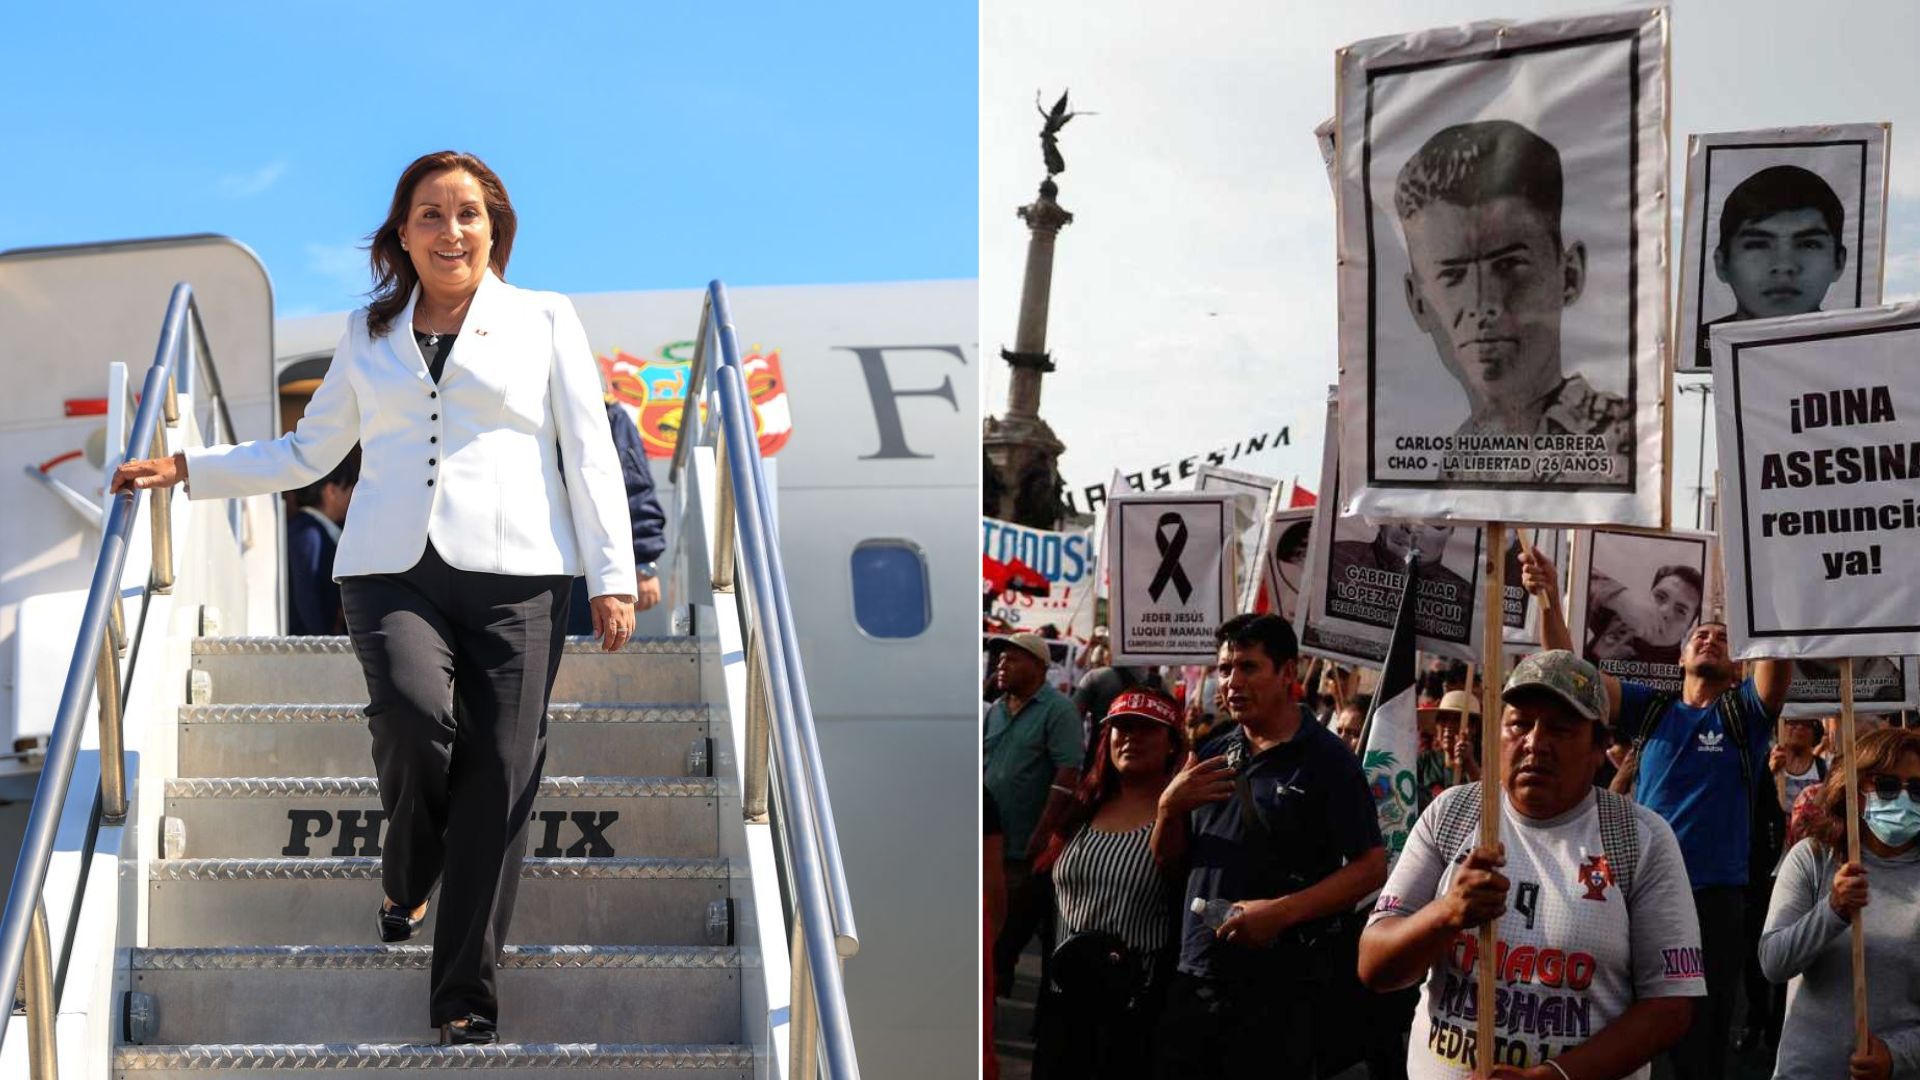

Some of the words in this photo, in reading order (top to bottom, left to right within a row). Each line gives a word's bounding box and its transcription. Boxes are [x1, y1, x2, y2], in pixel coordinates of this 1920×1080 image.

[1790, 385, 1896, 434] ¡DINA
[1127, 425, 1291, 492] ASESINA
[1395, 436, 1453, 451] CARLOS
[1457, 436, 1529, 451] HUAMAN
[1534, 436, 1606, 451] CABRERA
[1388, 456, 1428, 470] CHAO
[1443, 457, 1460, 471] LA
[1463, 457, 1531, 471] LIBERTAD
[1534, 457, 1559, 474] (26
[1563, 454, 1615, 474] AÑOS)
[1762, 499, 1920, 537] renunci
[1345, 565, 1406, 588] GABRIEL
[1822, 545, 1882, 580] ya!
[1337, 579, 1385, 605] LÓPEZ
[1141, 612, 1171, 623] JEDER
[1174, 609, 1205, 623] JESÚS
[1131, 626, 1167, 637] LUQUE
[1169, 626, 1213, 637] MAMANI
[1601, 659, 1649, 675] NELSON
[281, 809, 620, 858] PHIX
[1449, 930, 1597, 991] TIAGO
[1428, 1015, 1528, 1071] PEDRTO
